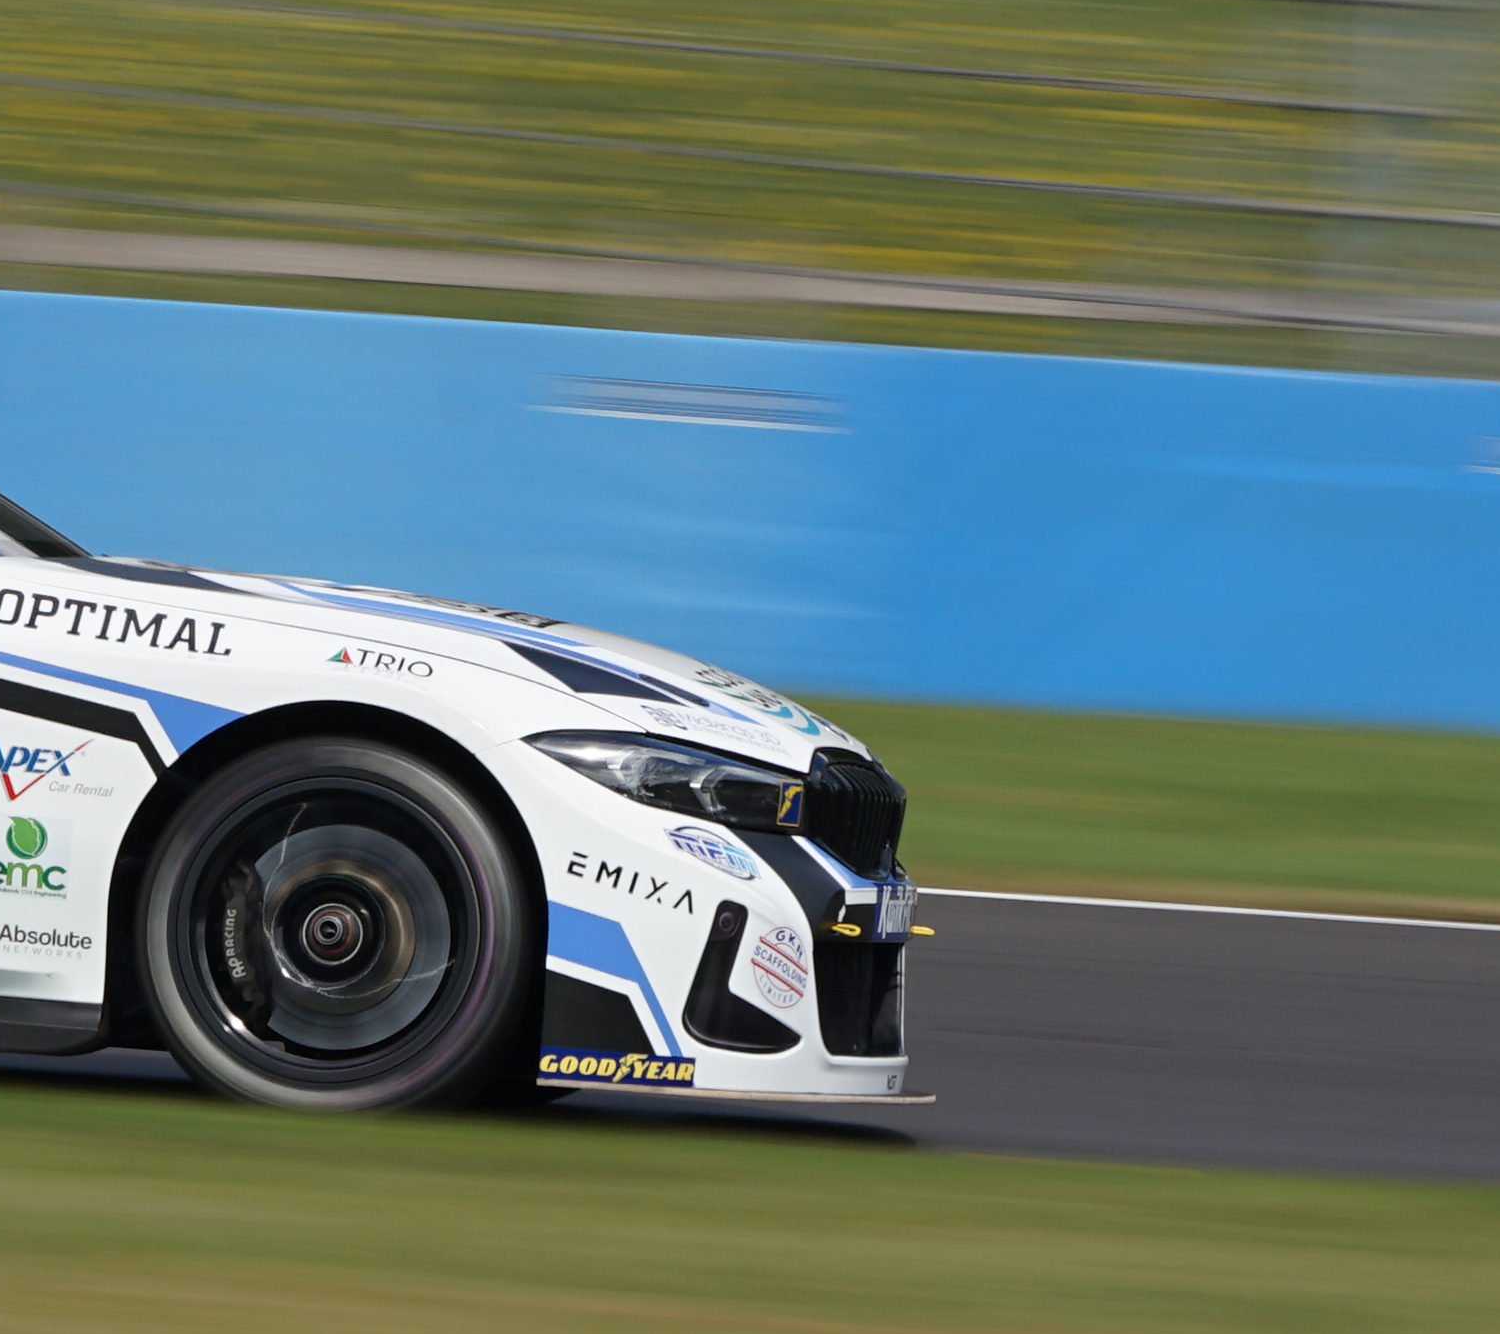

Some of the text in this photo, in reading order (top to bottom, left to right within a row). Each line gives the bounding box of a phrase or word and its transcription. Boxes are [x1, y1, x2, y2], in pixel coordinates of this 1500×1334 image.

[356, 648, 434, 678] TRIO
[49, 780, 114, 797] Car Rental
[567, 851, 694, 915] EMIXA
[224, 908, 237, 957] RACING
[2, 945, 83, 959] NETWORKS
[753, 945, 807, 989] SCAFFOLDING
[540, 1054, 695, 1083] GOODYEAR
